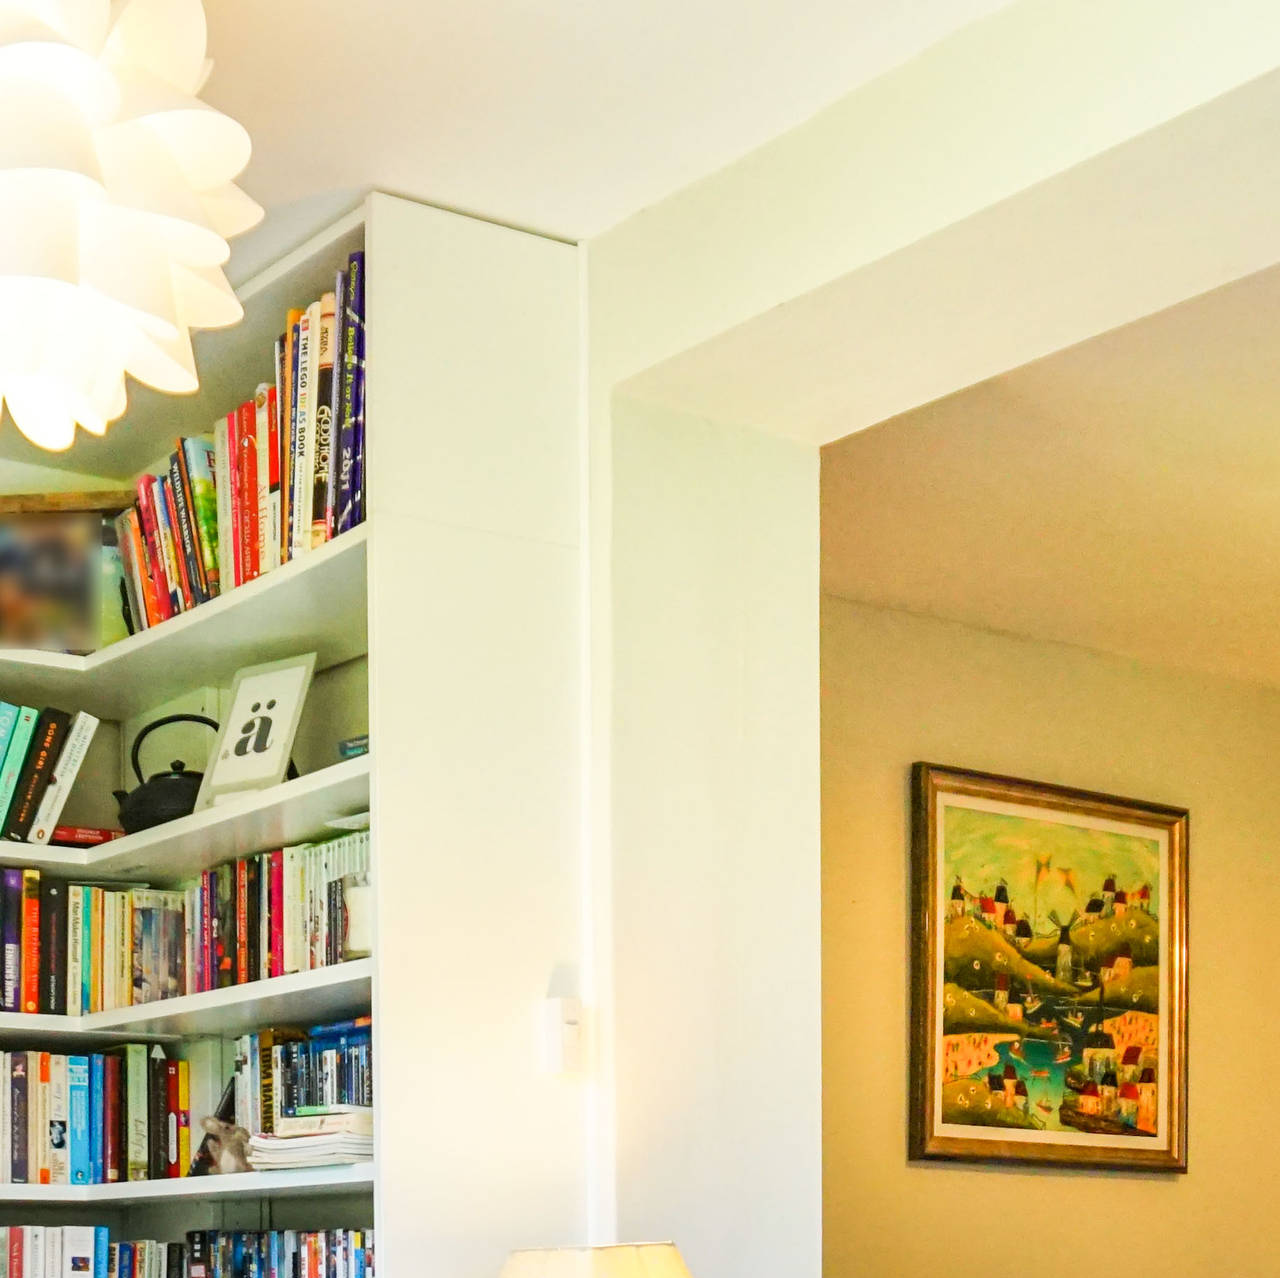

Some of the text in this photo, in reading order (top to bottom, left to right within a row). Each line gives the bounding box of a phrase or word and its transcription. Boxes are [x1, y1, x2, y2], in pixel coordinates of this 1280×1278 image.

[299, 336, 309, 359] THE
[343, 326, 357, 369] Believe
[298, 360, 308, 389] LEGO
[297, 427, 307, 458] BOOK
[339, 446, 353, 491] 2011
[170, 462, 193, 556] WILDLIFE WARRIOR
[43, 721, 58, 748] GONE
